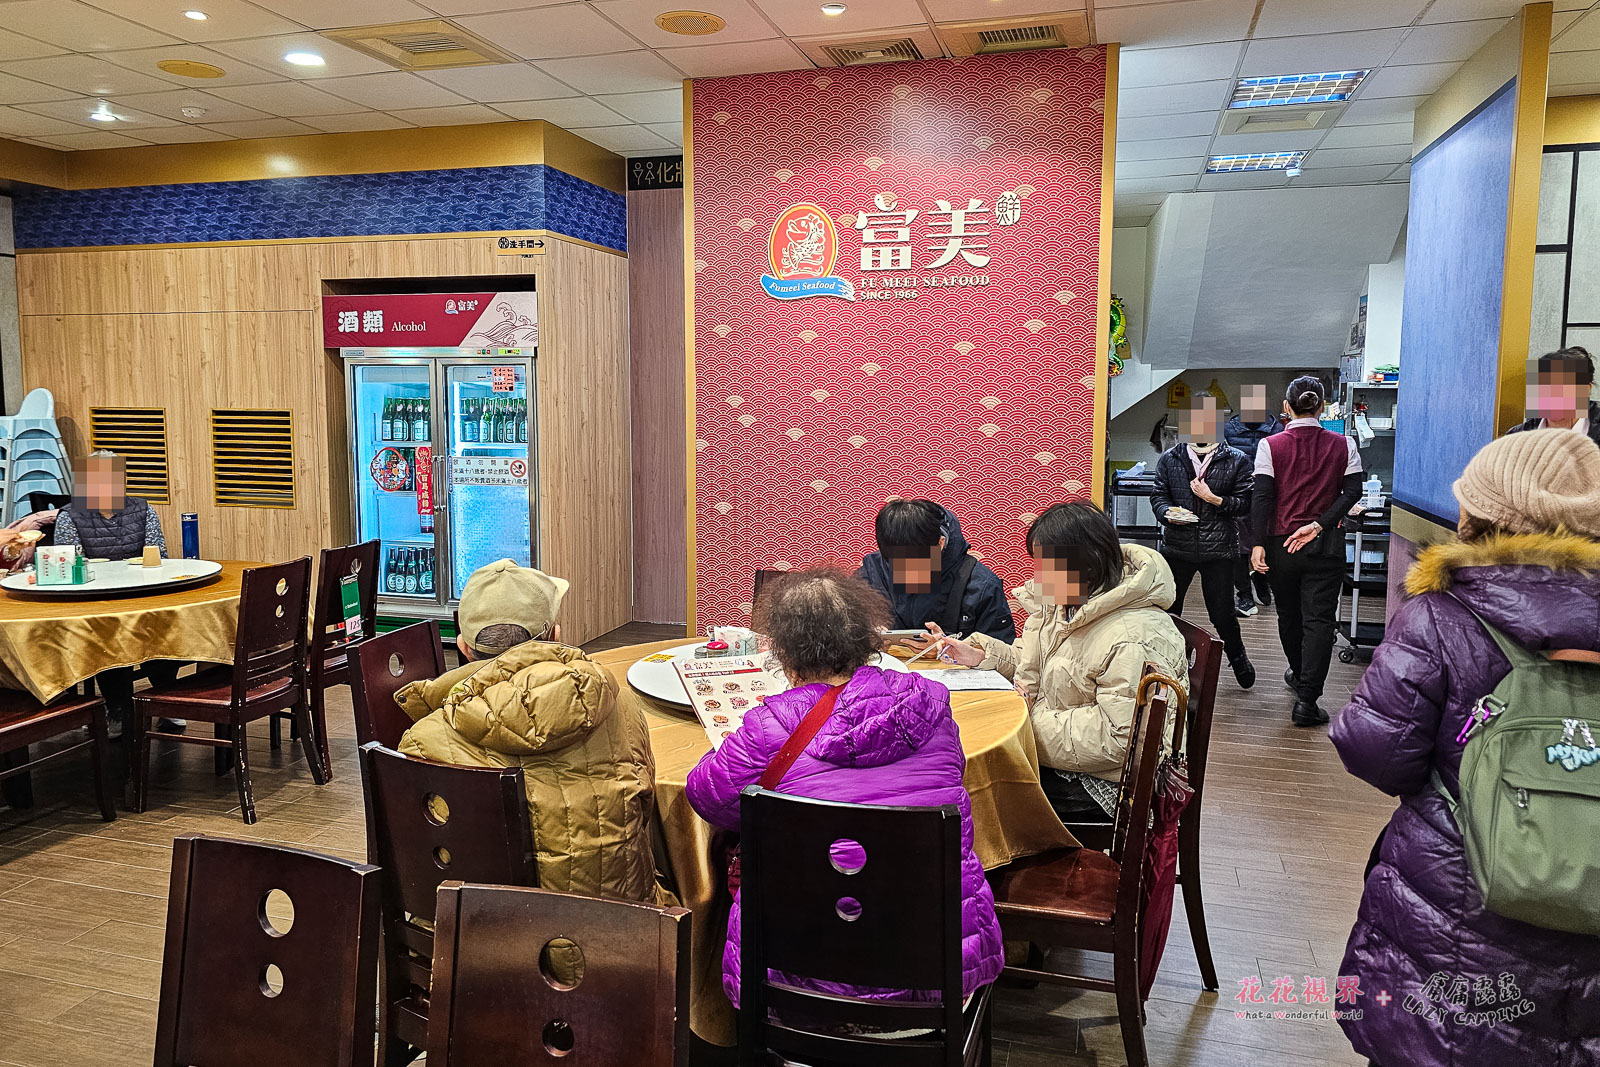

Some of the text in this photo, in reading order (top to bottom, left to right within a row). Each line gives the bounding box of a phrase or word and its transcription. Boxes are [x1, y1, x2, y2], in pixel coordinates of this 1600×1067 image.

[855, 191, 1022, 271] 富美 鮮
[509, 239, 535, 249] 洗手間
[768, 280, 837, 293] Fumeei Seafood
[860, 274, 991, 289] FU MEEI SEAFOOD
[860, 290, 918, 300] SINCE 1966
[337, 309, 426, 333] 酒類 Alcohol
